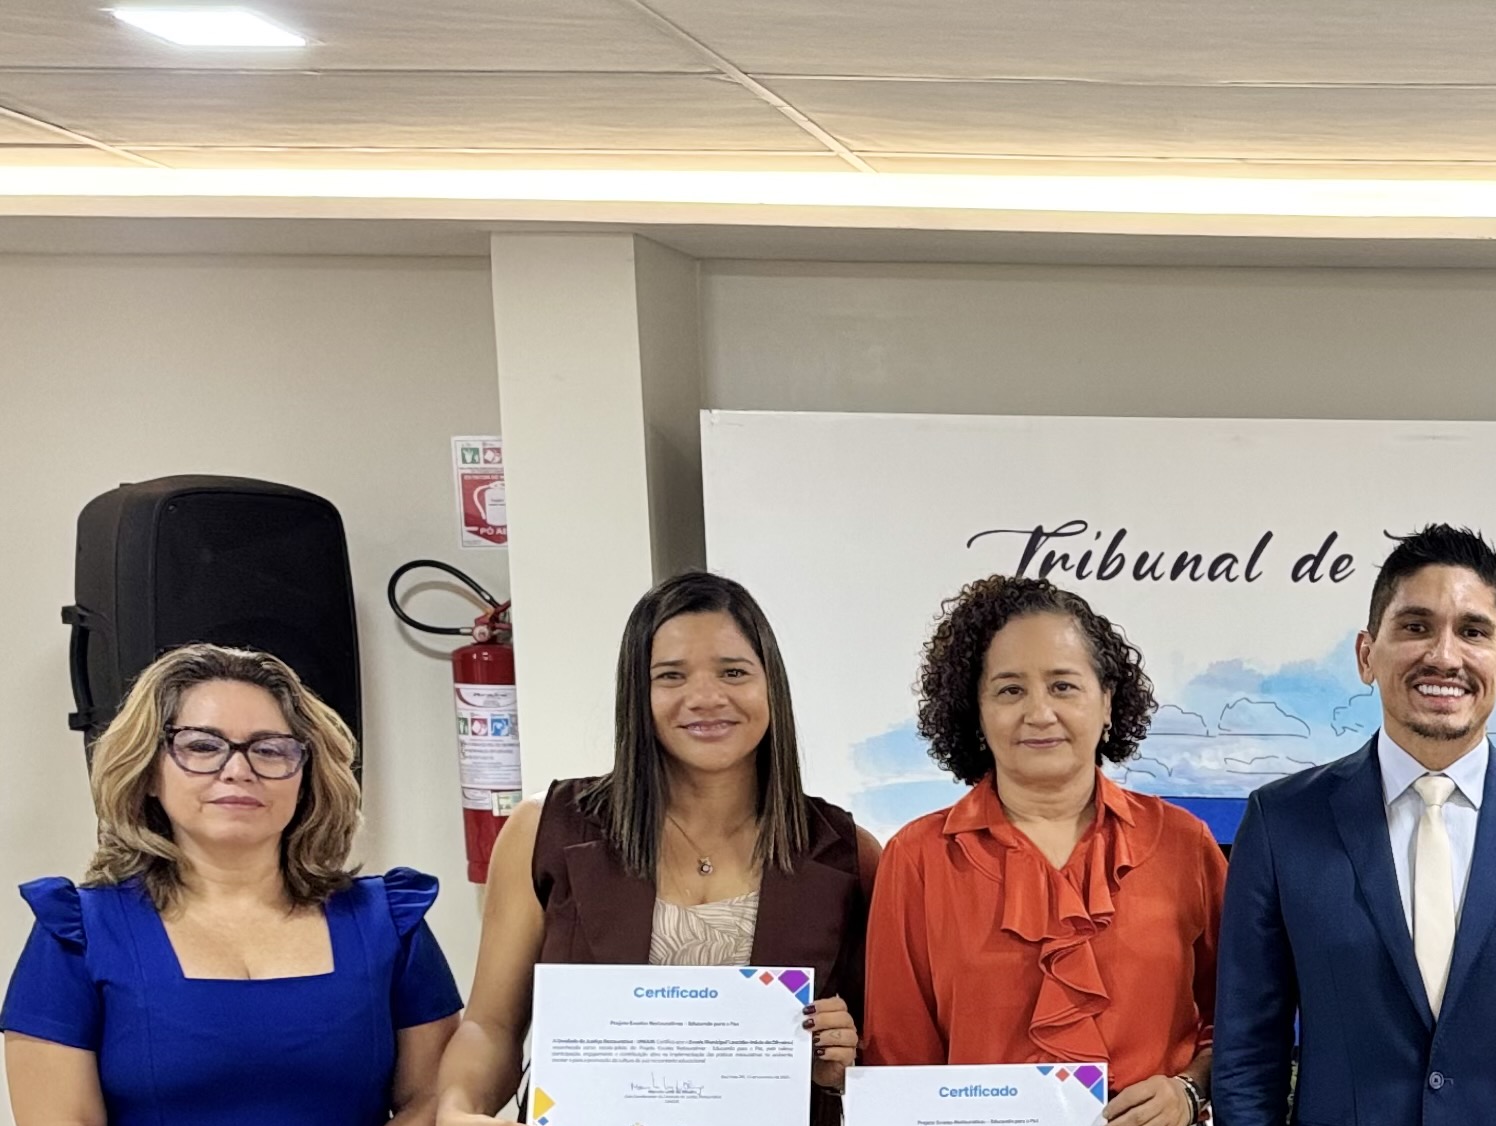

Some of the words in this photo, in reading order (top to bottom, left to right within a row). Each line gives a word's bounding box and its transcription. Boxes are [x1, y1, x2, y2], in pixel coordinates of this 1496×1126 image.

[966, 519, 1273, 582] Tribunal
[1290, 530, 1357, 583] de
[633, 986, 719, 999] Certificado
[939, 1085, 1018, 1097] Certificado
